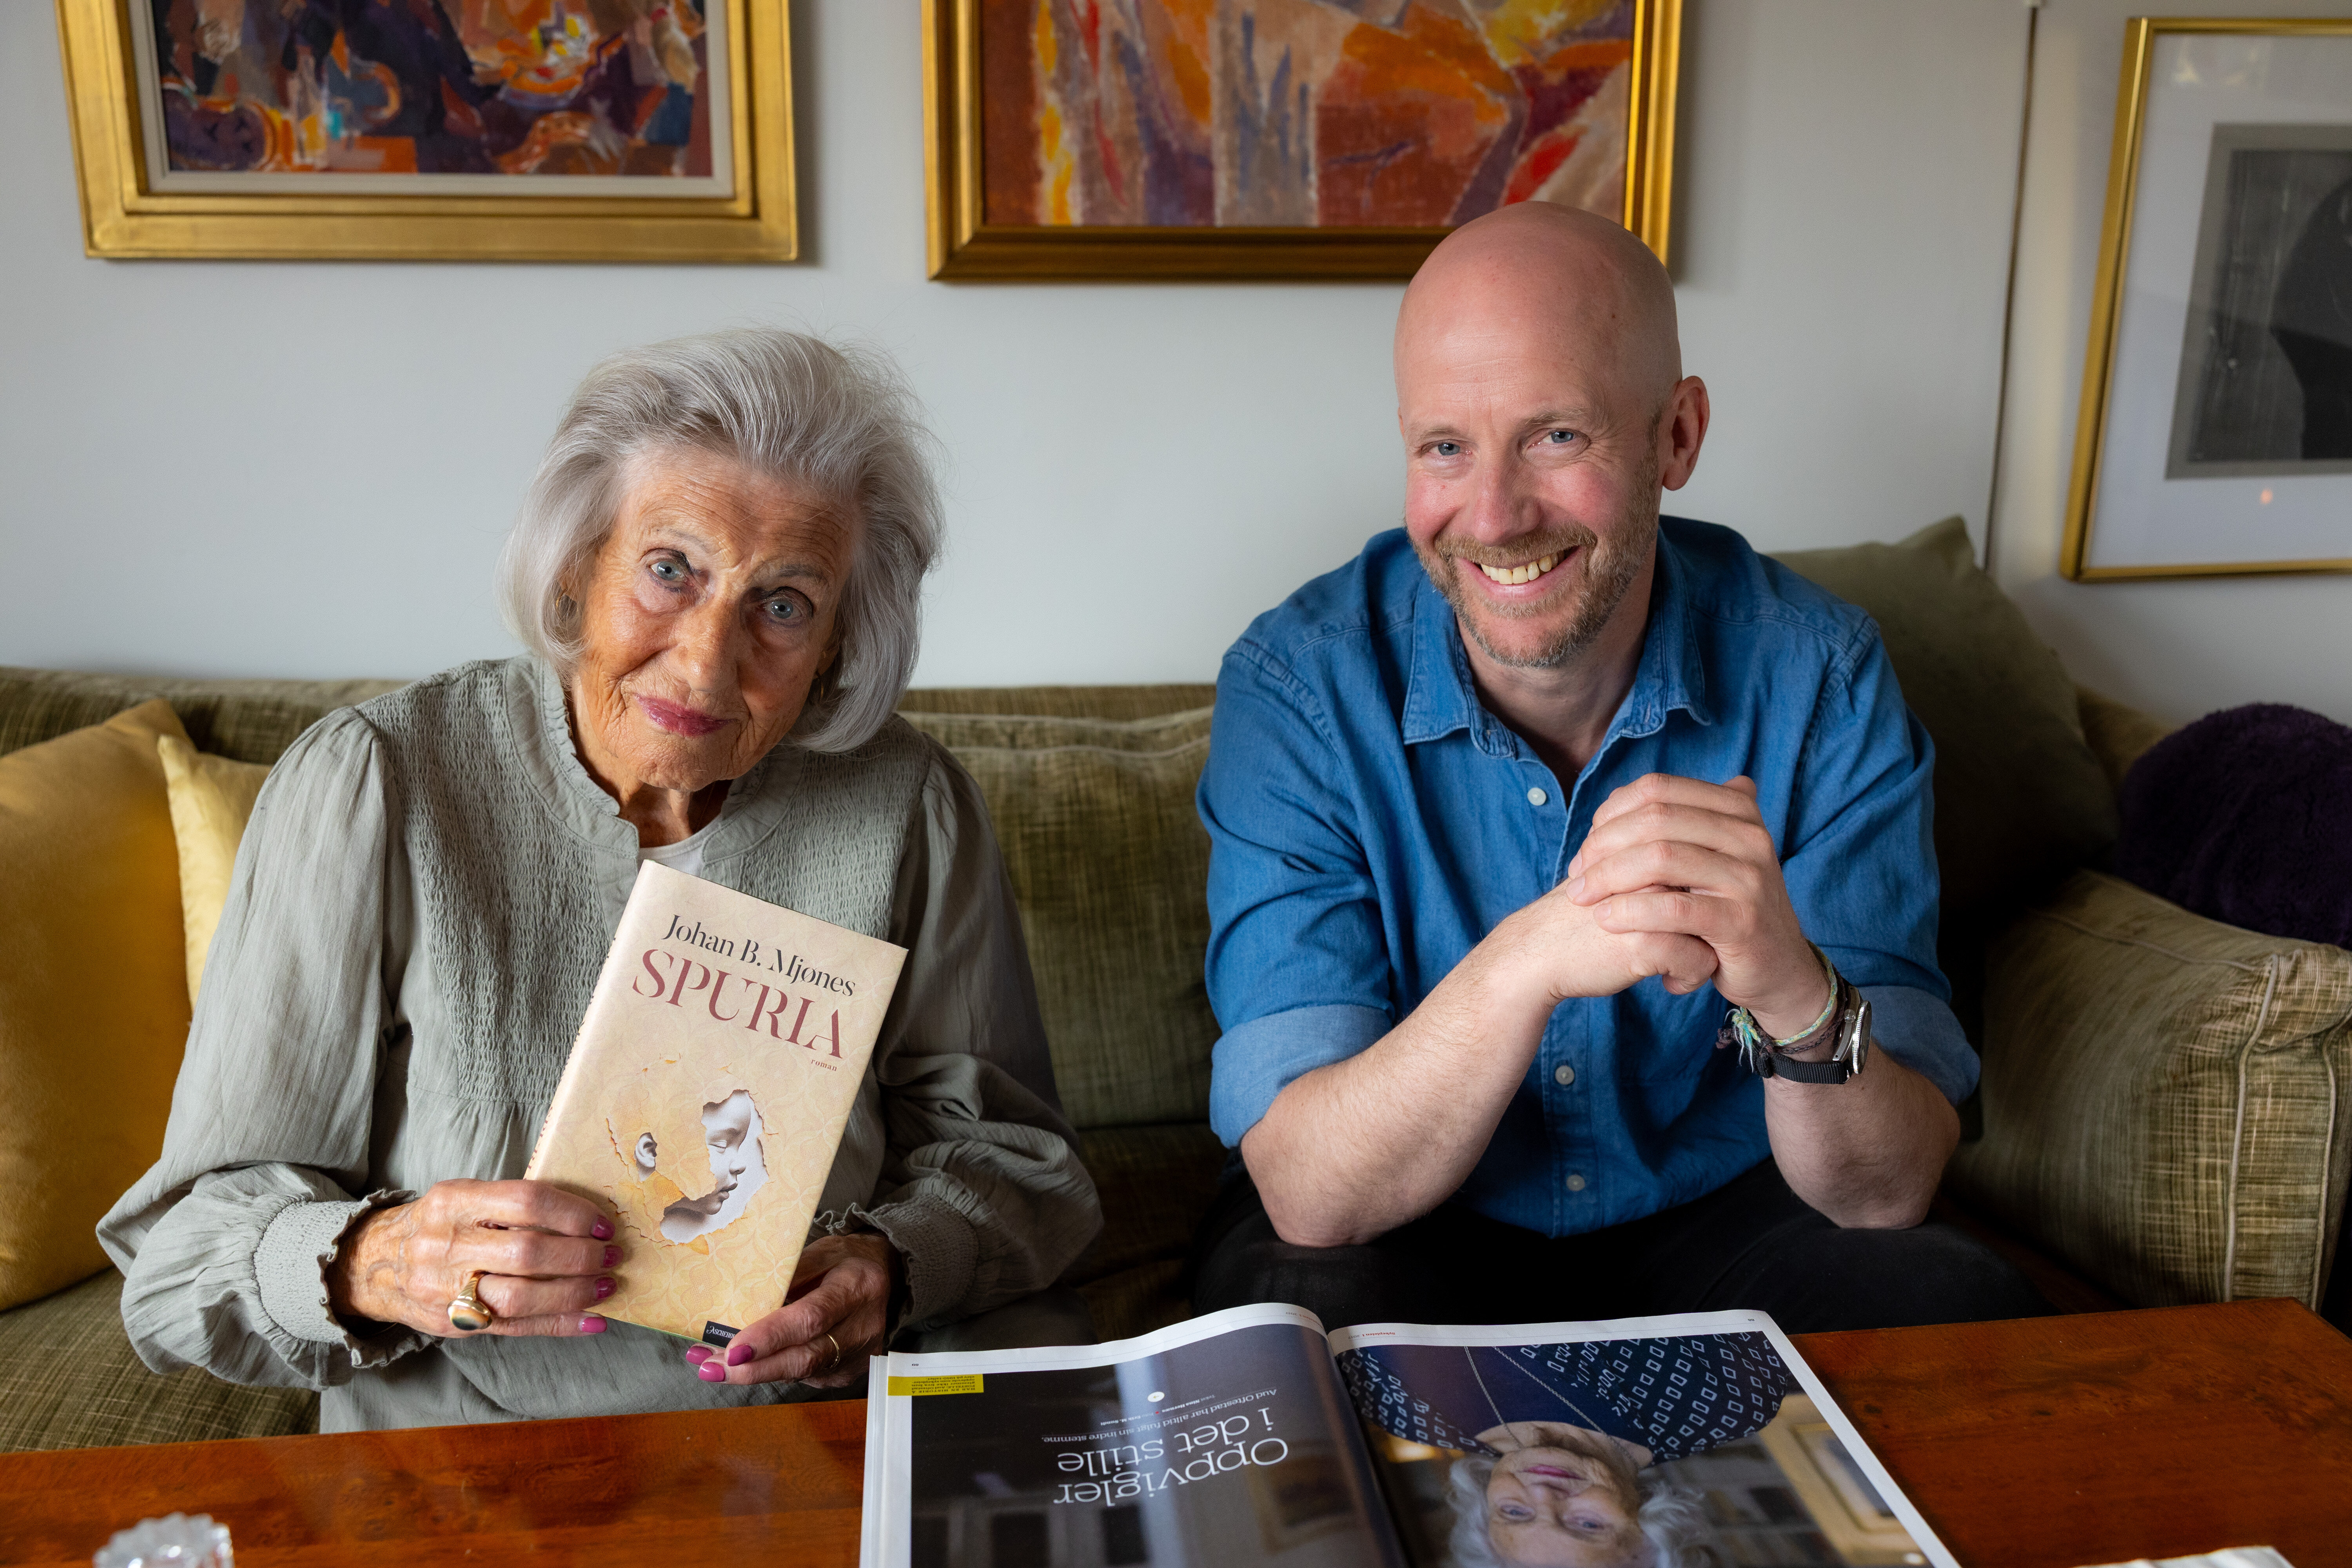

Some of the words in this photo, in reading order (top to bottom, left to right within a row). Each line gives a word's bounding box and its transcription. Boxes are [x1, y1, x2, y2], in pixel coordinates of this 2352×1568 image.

[661, 914, 734, 957] Johan
[740, 939, 760, 966] B.
[767, 949, 855, 996] Mjønes
[632, 949, 842, 1059] SPURIA
[811, 1060, 837, 1071] roman
[1256, 1389, 1277, 1399] Aud
[1210, 1394, 1254, 1413] Oftestad
[1162, 1414, 1189, 1427] alltid
[1191, 1408, 1209, 1418] har
[1258, 1407, 1274, 1431] i
[1089, 1431, 1117, 1440] indre
[1118, 1428, 1134, 1436] sin
[1137, 1422, 1161, 1433] fulgt
[1174, 1415, 1250, 1453] det
[1057, 1439, 1164, 1476] stille
[1053, 1438, 1288, 1506] Oppvigler
